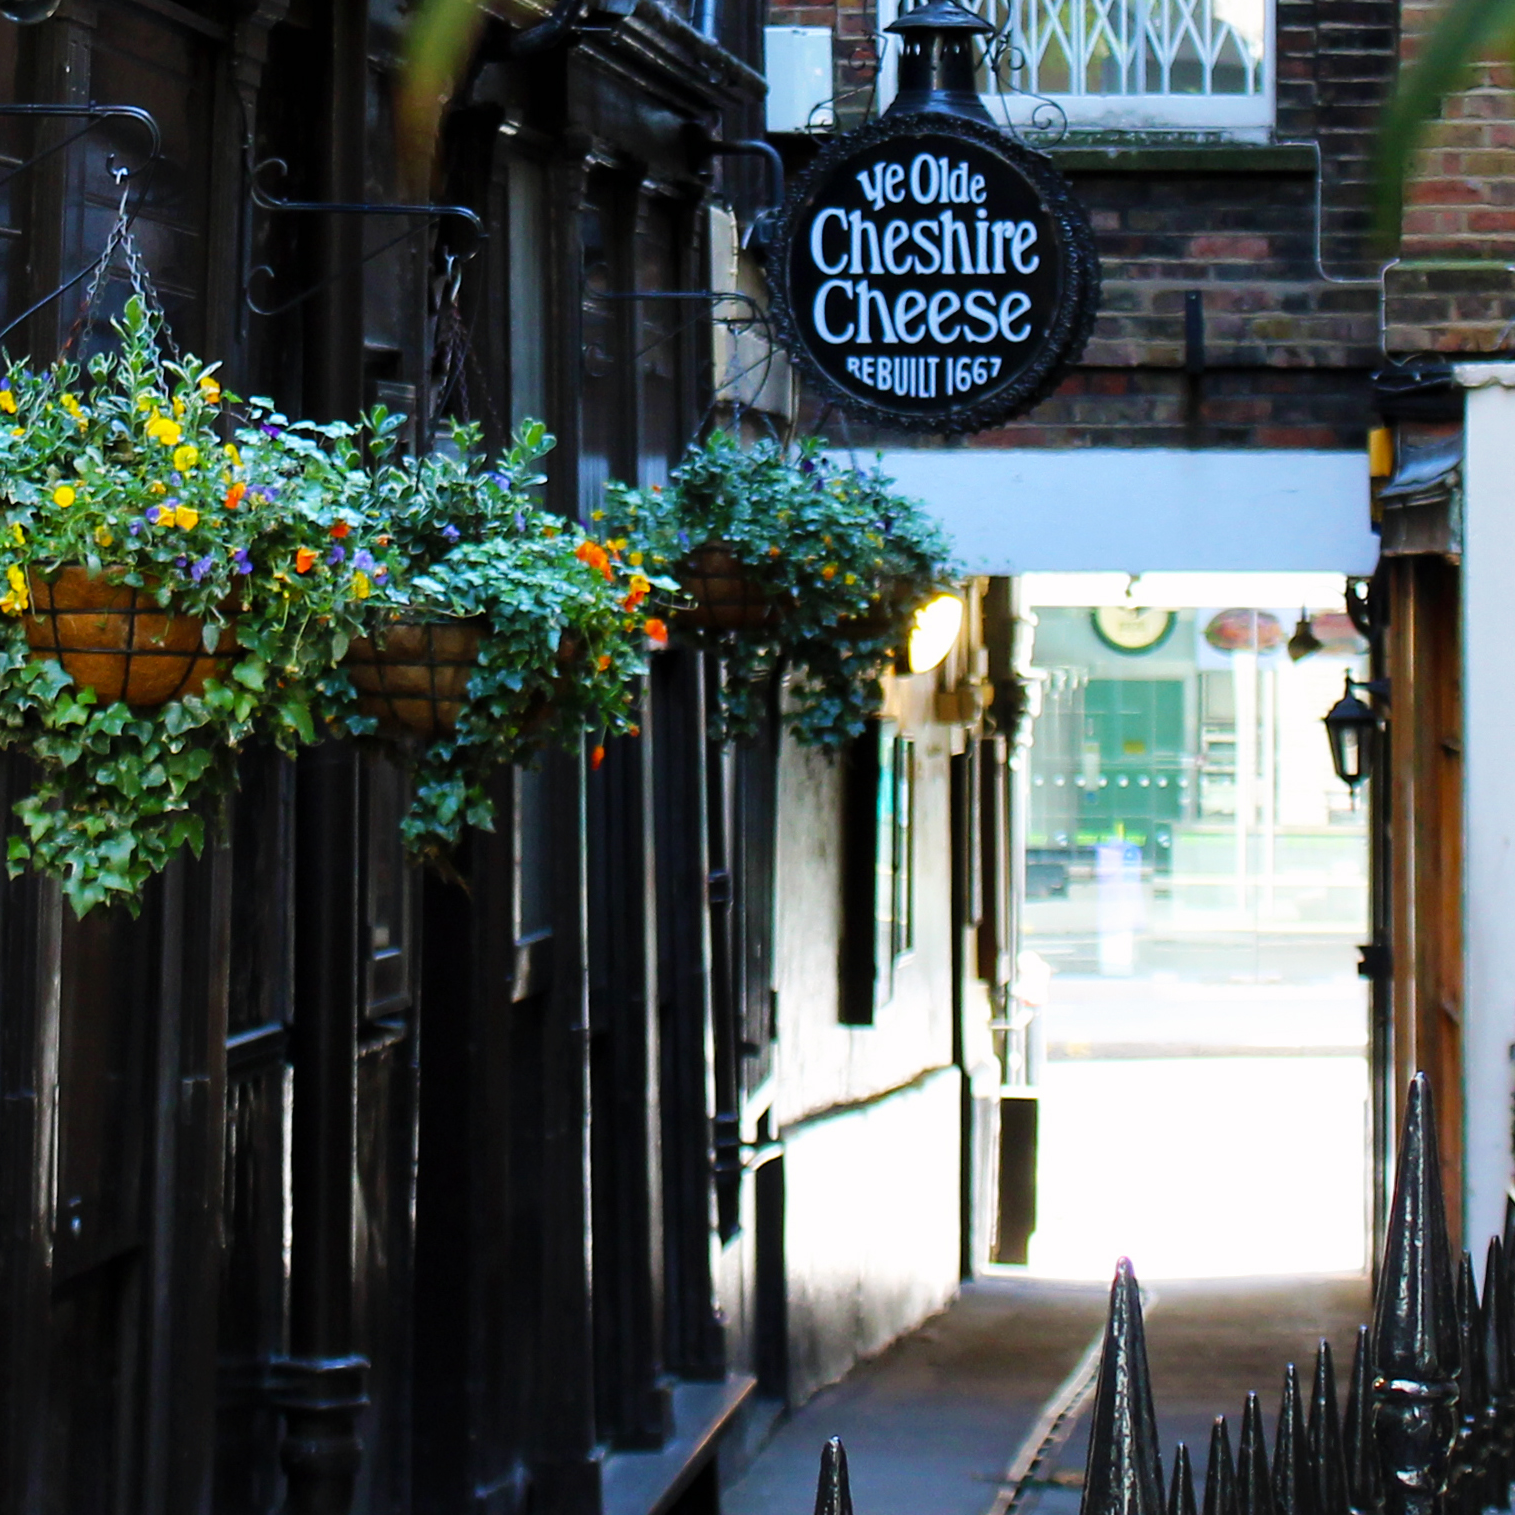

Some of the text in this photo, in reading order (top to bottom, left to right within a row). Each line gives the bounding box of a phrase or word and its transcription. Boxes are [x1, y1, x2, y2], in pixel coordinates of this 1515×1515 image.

[909, 152, 988, 205] Olde
[810, 207, 1041, 276] Cheshire
[812, 278, 1033, 345] Cheese
[846, 355, 1003, 399] REBUILT 1667
